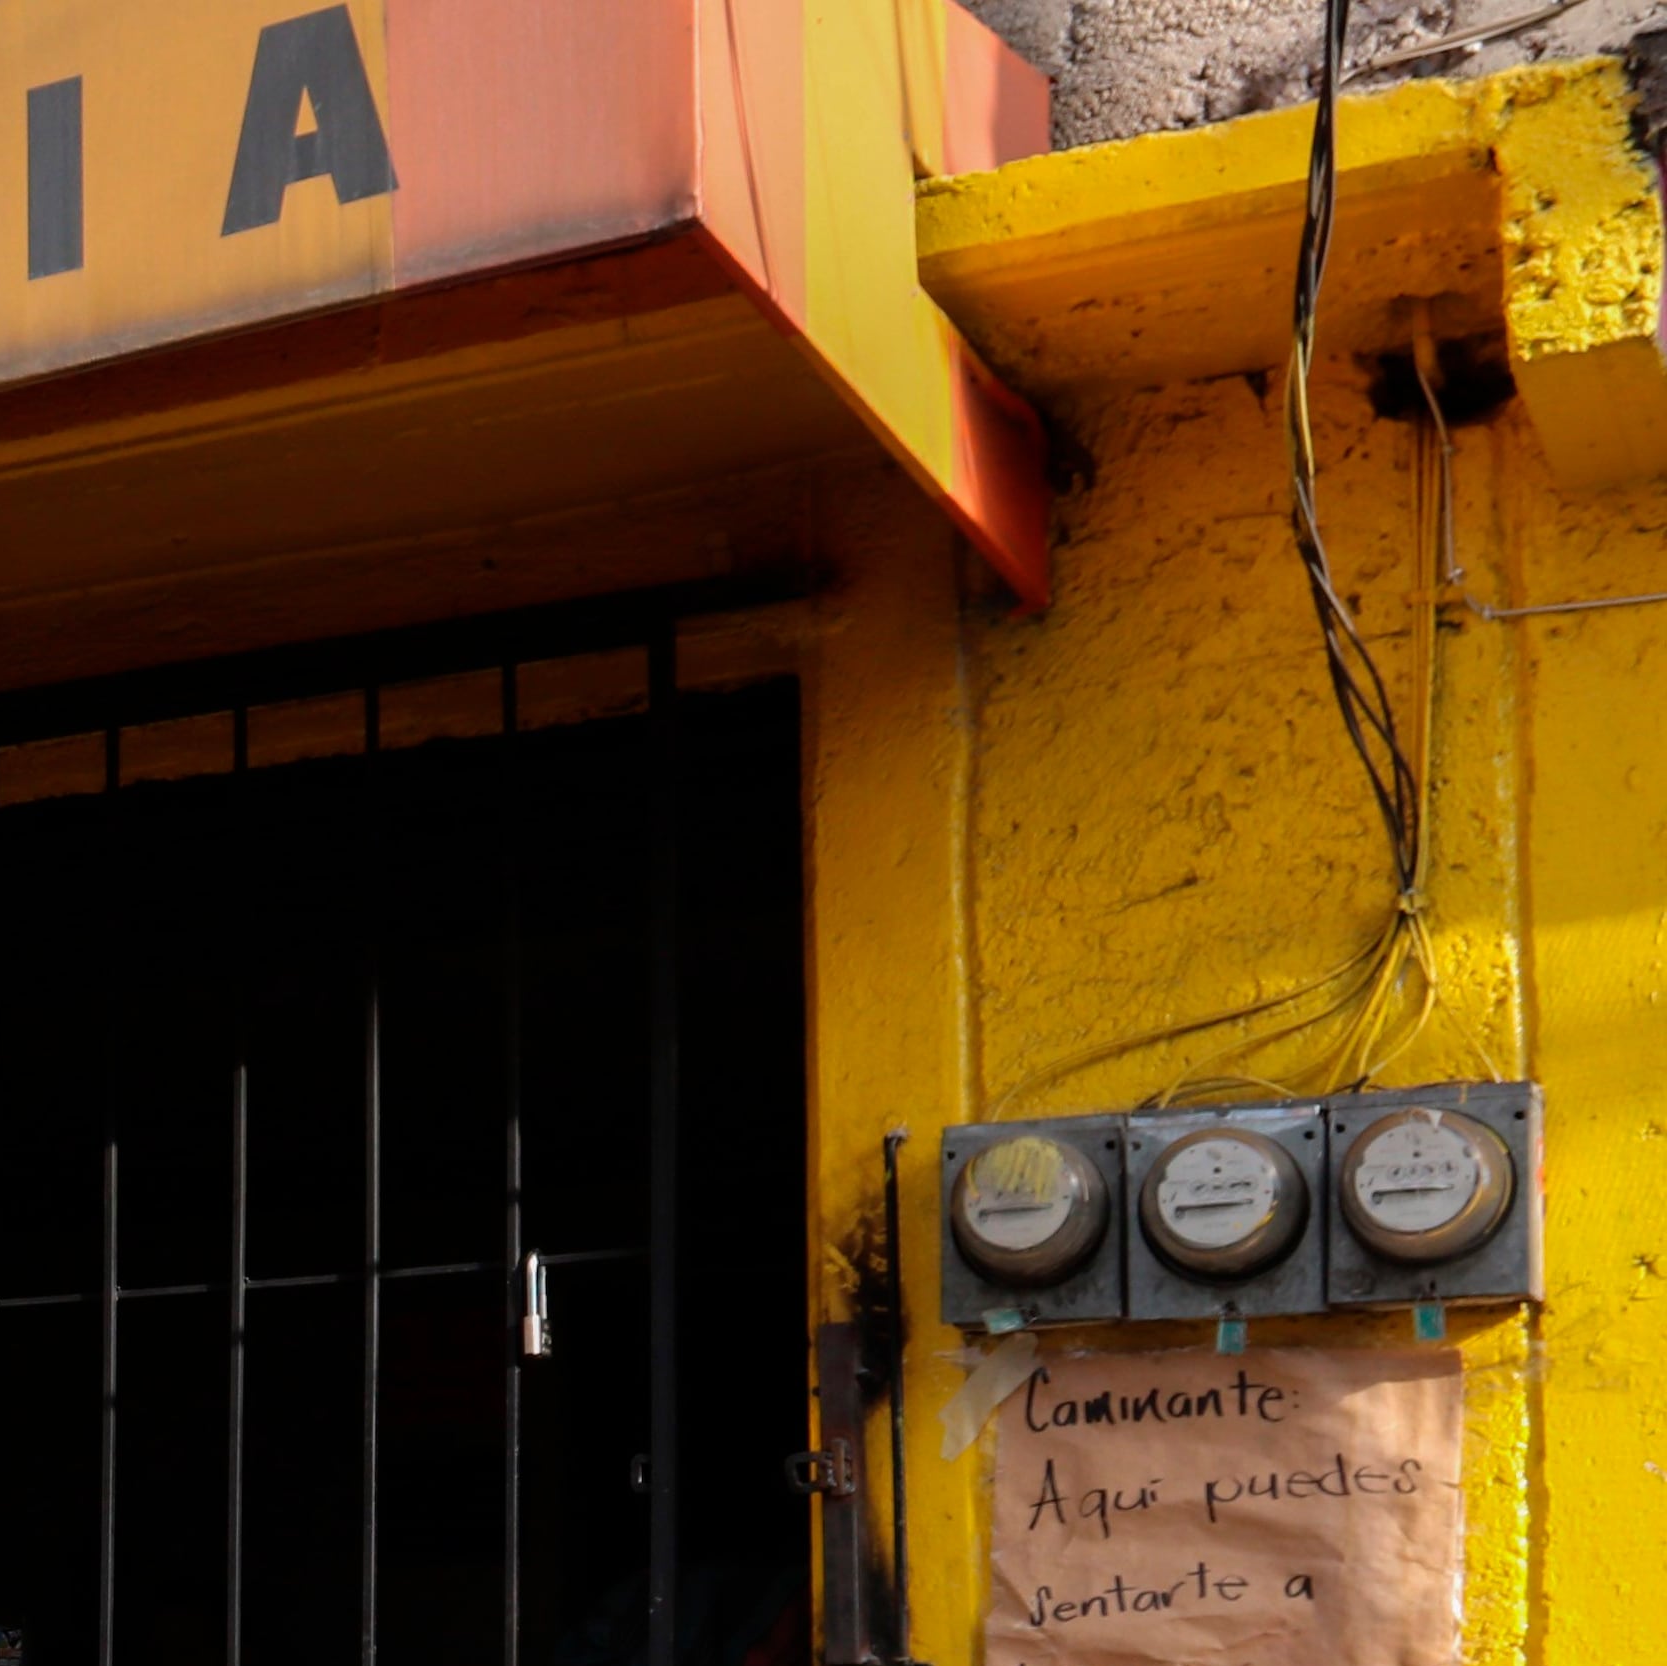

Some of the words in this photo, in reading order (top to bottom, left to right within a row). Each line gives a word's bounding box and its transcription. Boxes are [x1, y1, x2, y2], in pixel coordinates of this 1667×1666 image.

[1024, 1366, 1302, 1433] Caminante:
[1204, 1452, 1422, 1524] puedes
[1284, 1572, 1315, 1600] a
